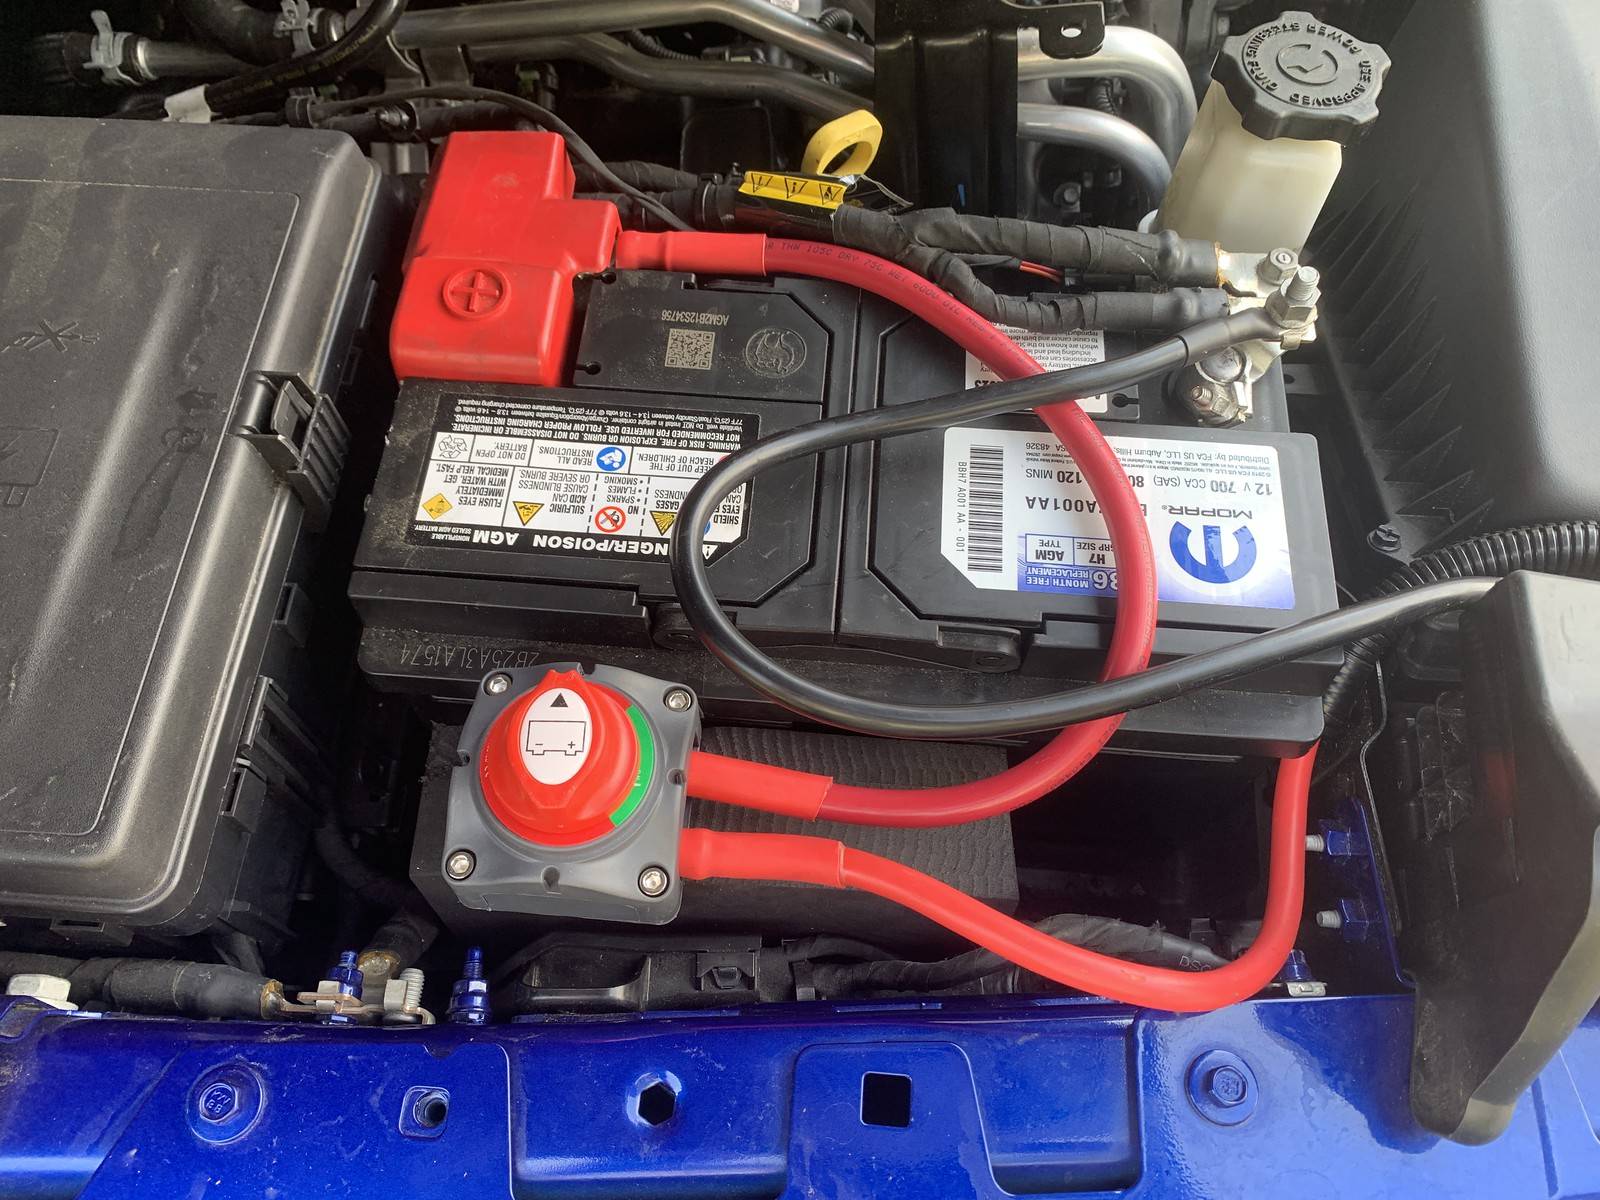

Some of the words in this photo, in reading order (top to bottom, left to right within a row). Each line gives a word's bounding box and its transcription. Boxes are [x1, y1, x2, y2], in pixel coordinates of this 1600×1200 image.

[454, 414, 506, 424] INSTRUCTIONS.
[506, 418, 543, 428] CHARGING
[451, 423, 492, 433] INCINERATE.
[493, 426, 504, 434] OR
[544, 421, 572, 430] PROPER
[572, 423, 602, 432] FOLLOW
[604, 425, 619, 433] USE.
[505, 427, 552, 438] DISASSEMBLE
[553, 430, 568, 439] NOT
[570, 432, 579, 440] DO
[621, 426, 655, 436] INVERTED
[656, 429, 670, 437] FOR
[672, 430, 724, 440] RECOMMENDED
[582, 433, 607, 442] BURNS.
[608, 435, 618, 443] OR
[620, 436, 658, 445] EXPLOSION
[726, 433, 740, 441] NOT
[494, 442, 527, 452] BATTERY.
[678, 439, 687, 447] OF
[689, 440, 705, 449] RISK
[707, 441, 741, 450] WARNING:
[1026, 442, 1050, 451] 48326
[475, 449, 496, 458] OPEN
[498, 451, 513, 459] NOT
[515, 452, 526, 460] DO
[537, 445, 594, 457] INSTRUCTIONS.
[1134, 449, 1161, 458] Auburn
[1164, 450, 1180, 458] LLC,
[557, 456, 570, 464] ALL
[572, 457, 592, 466] READ
[636, 453, 676, 463] CHILDREN.
[677, 456, 687, 464] OF
[689, 456, 715, 465] REACH
[1229, 454, 1270, 464] Distributed
[436, 463, 454, 473] FAST.
[457, 464, 475, 474] HELP
[477, 466, 509, 476] MEDICAL
[649, 462, 663, 470] THE
[665, 463, 676, 471] OF
[677, 464, 692, 472] OUT
[519, 469, 547, 479] BURNS.
[549, 472, 578, 482] SEVERE
[958, 461, 967, 483] BBH7
[1026, 468, 1053, 479] MINS
[443, 474, 458, 483] GET
[488, 477, 506, 487] WITH
[580, 474, 590, 483] OR
[604, 475, 638, 485] SMOKING
[1057, 471, 1082, 484] 120
[1153, 476, 1180, 487] (SAE)
[518, 479, 562, 492] BLINDNESS
[563, 483, 589, 493] CAUSE
[1184, 478, 1206, 488] CCA
[1210, 480, 1236, 493] 700
[456, 486, 505, 497] IMMEDIATELY
[608, 485, 636, 494] FLAMES
[1255, 483, 1272, 495] 12
[458, 496, 477, 506] EYES
[552, 493, 568, 502] CAN
[570, 494, 587, 503] ACID
[606, 494, 635, 503] SPARKS
[725, 494, 741, 504] CAN
[957, 487, 966, 507] A001
[480, 497, 502, 508] FLUSH
[655, 500, 680, 510] GASES
[549, 503, 585, 514] SULFURIC
[628, 505, 639, 514] NO
[722, 504, 740, 514] EYES
[713, 514, 739, 525] SHIELD
[957, 512, 966, 524] AA
[431, 533, 470, 542] NONSPILLABLE
[472, 529, 519, 546] AGM
[532, 534, 669, 556] NGER/POISON
[956, 536, 965, 553] 001
[1038, 539, 1061, 548] TYPE
[1076, 542, 1096, 550] SIZE
[1035, 549, 1064, 561] AGM
[1088, 553, 1106, 564] H7
[1026, 566, 1089, 578] REPLACEMENT
[1026, 576, 1049, 586] FREE
[1052, 578, 1089, 588] MONTH
